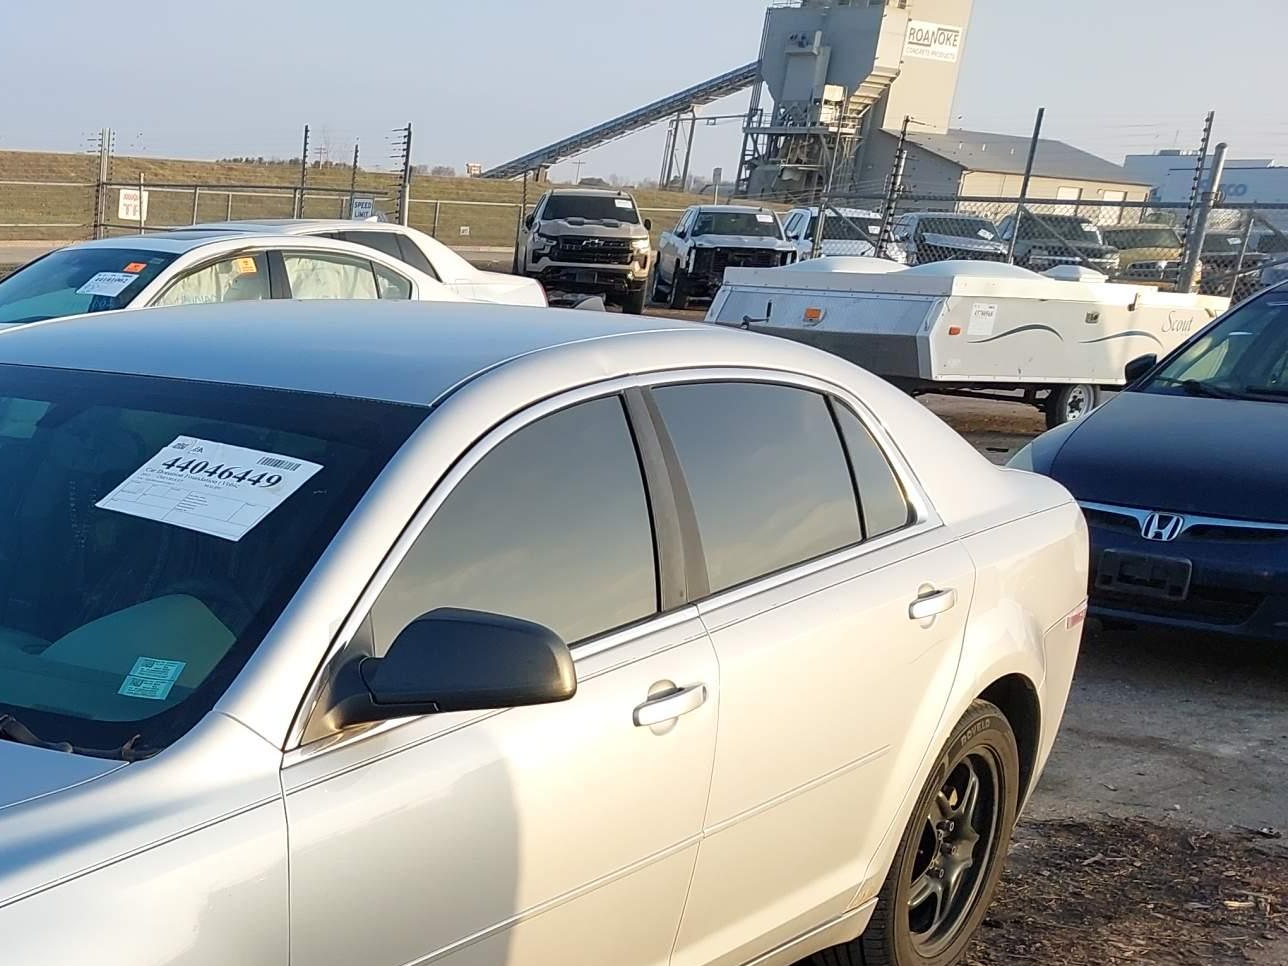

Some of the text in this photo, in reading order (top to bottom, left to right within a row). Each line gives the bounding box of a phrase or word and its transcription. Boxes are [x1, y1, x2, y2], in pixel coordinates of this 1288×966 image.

[908, 27, 960, 47] ROANOKE
[1161, 310, 1194, 333] Scout
[161, 456, 283, 488] 44046449
